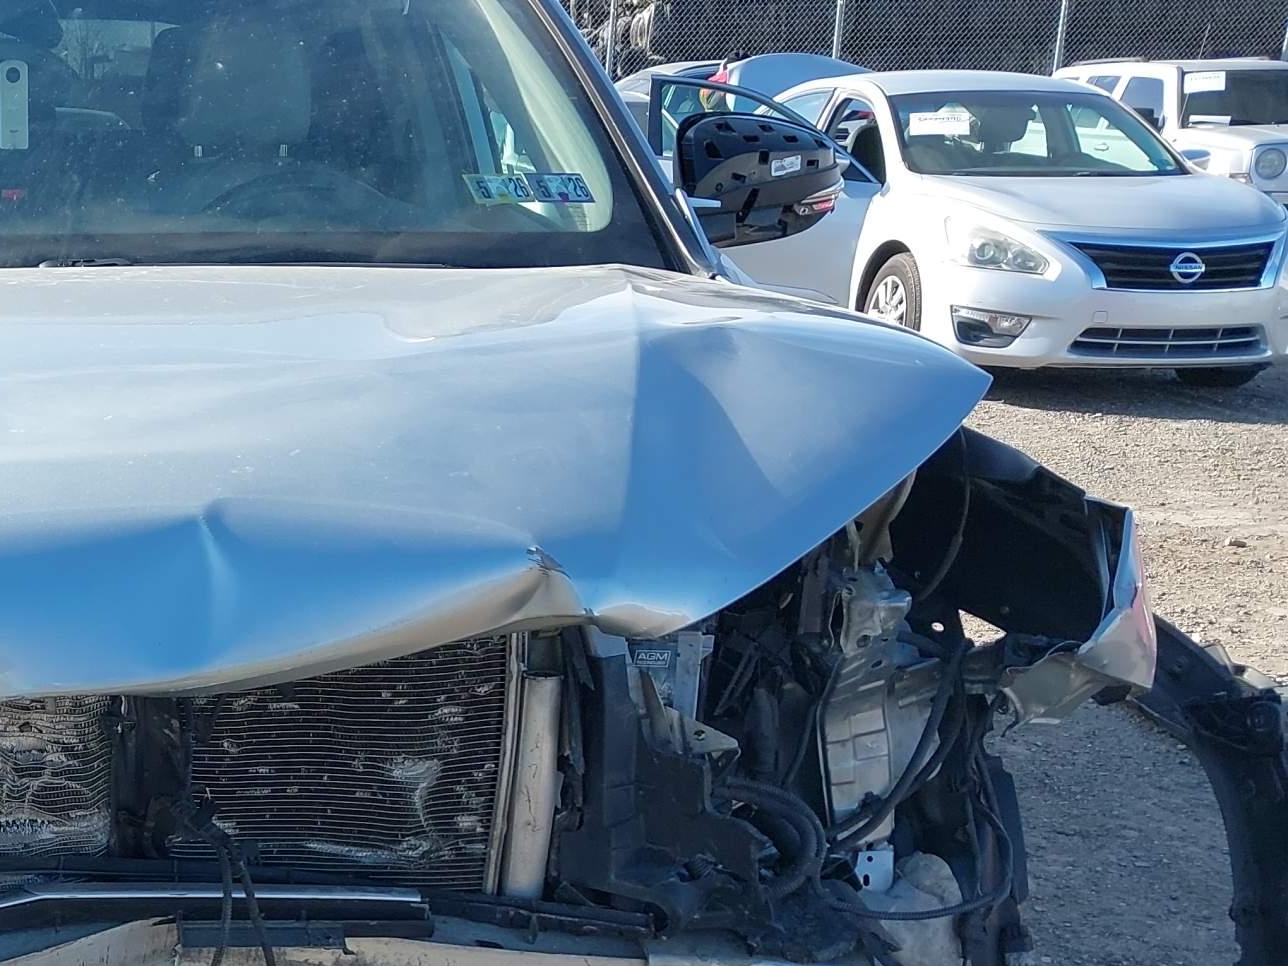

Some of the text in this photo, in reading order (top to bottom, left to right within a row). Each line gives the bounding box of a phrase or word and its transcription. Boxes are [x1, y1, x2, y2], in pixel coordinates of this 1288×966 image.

[476, 180, 492, 199] 5
[536, 179, 552, 199] 5
[637, 652, 668, 661] AGM
